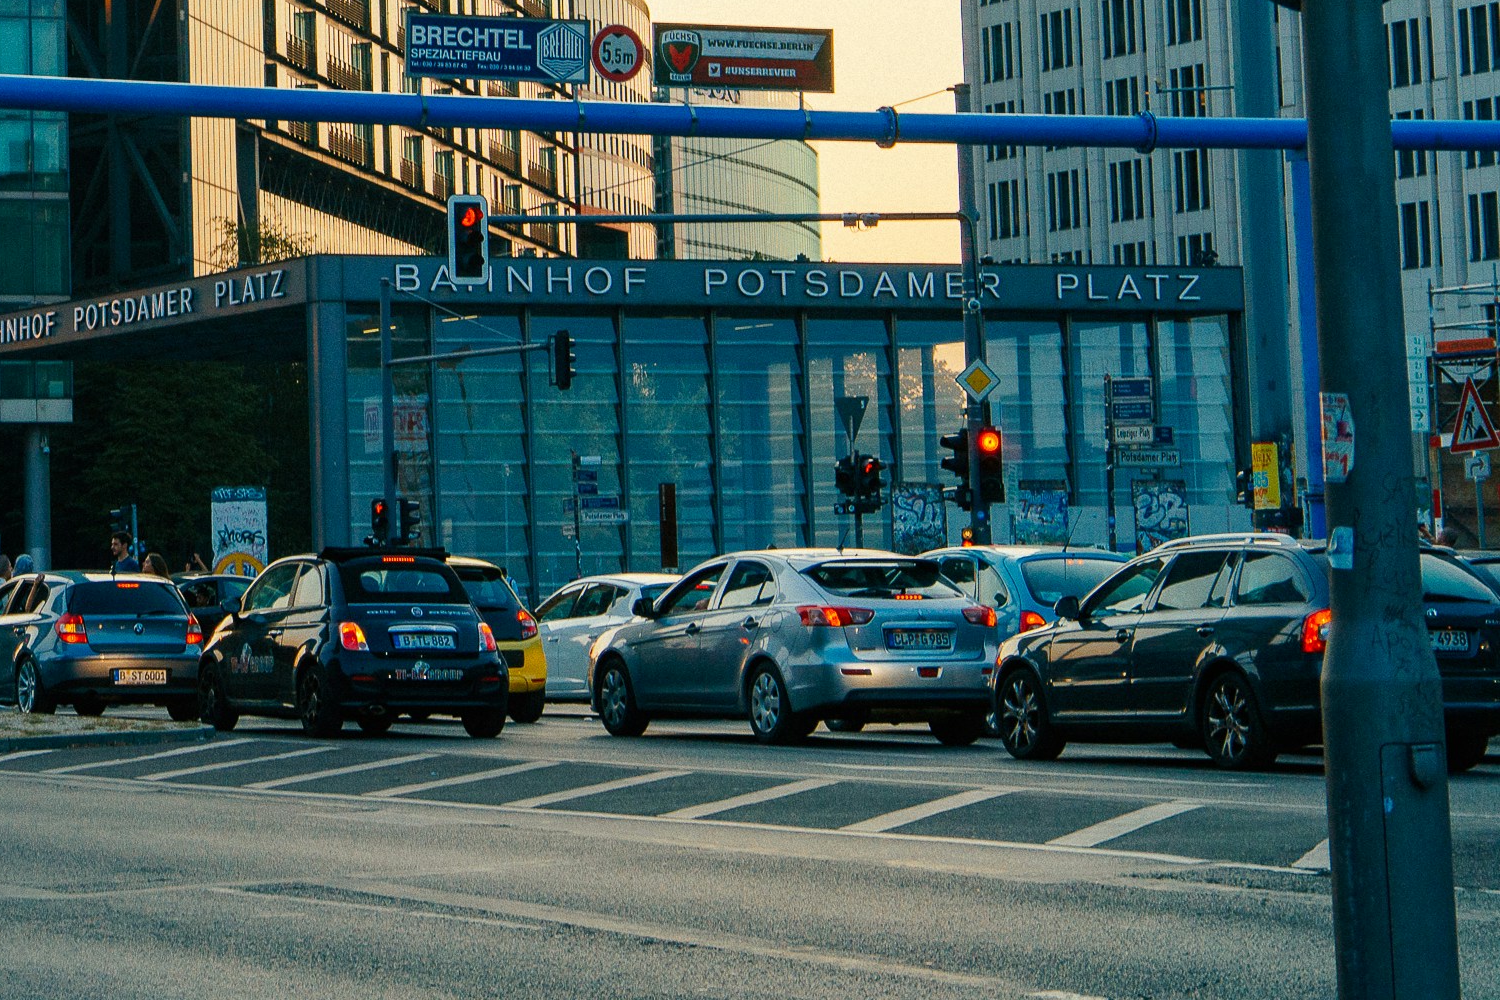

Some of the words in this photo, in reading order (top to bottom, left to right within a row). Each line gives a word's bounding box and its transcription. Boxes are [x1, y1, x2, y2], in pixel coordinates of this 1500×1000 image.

[411, 25, 532, 50] BRECHTEL
[543, 26, 583, 60] BRECHTEL
[664, 31, 697, 43] FÜCHSE
[707, 39, 814, 51] WWW.FUECHSE.BERLIN
[411, 48, 501, 62] SPEZIALTIEFBAU
[725, 66, 796, 77] #UNSERREVIER
[704, 267, 1001, 300] POTSDAMER
[1056, 273, 1201, 301] PLATZ
[73, 286, 194, 333] POTSDAMER
[214, 269, 286, 308] PLATZ
[403, 635, 411, 646] B
[432, 635, 451, 646] 882
[894, 633, 915, 646] CLP
[921, 633, 929, 646] G
[929, 633, 949, 646] 985
[1437, 631, 1467, 647] 4938
[120, 671, 126, 680] B
[131, 671, 144, 681] ST
[144, 671, 165, 681] 6001
[427, 668, 464, 680] GROUP
